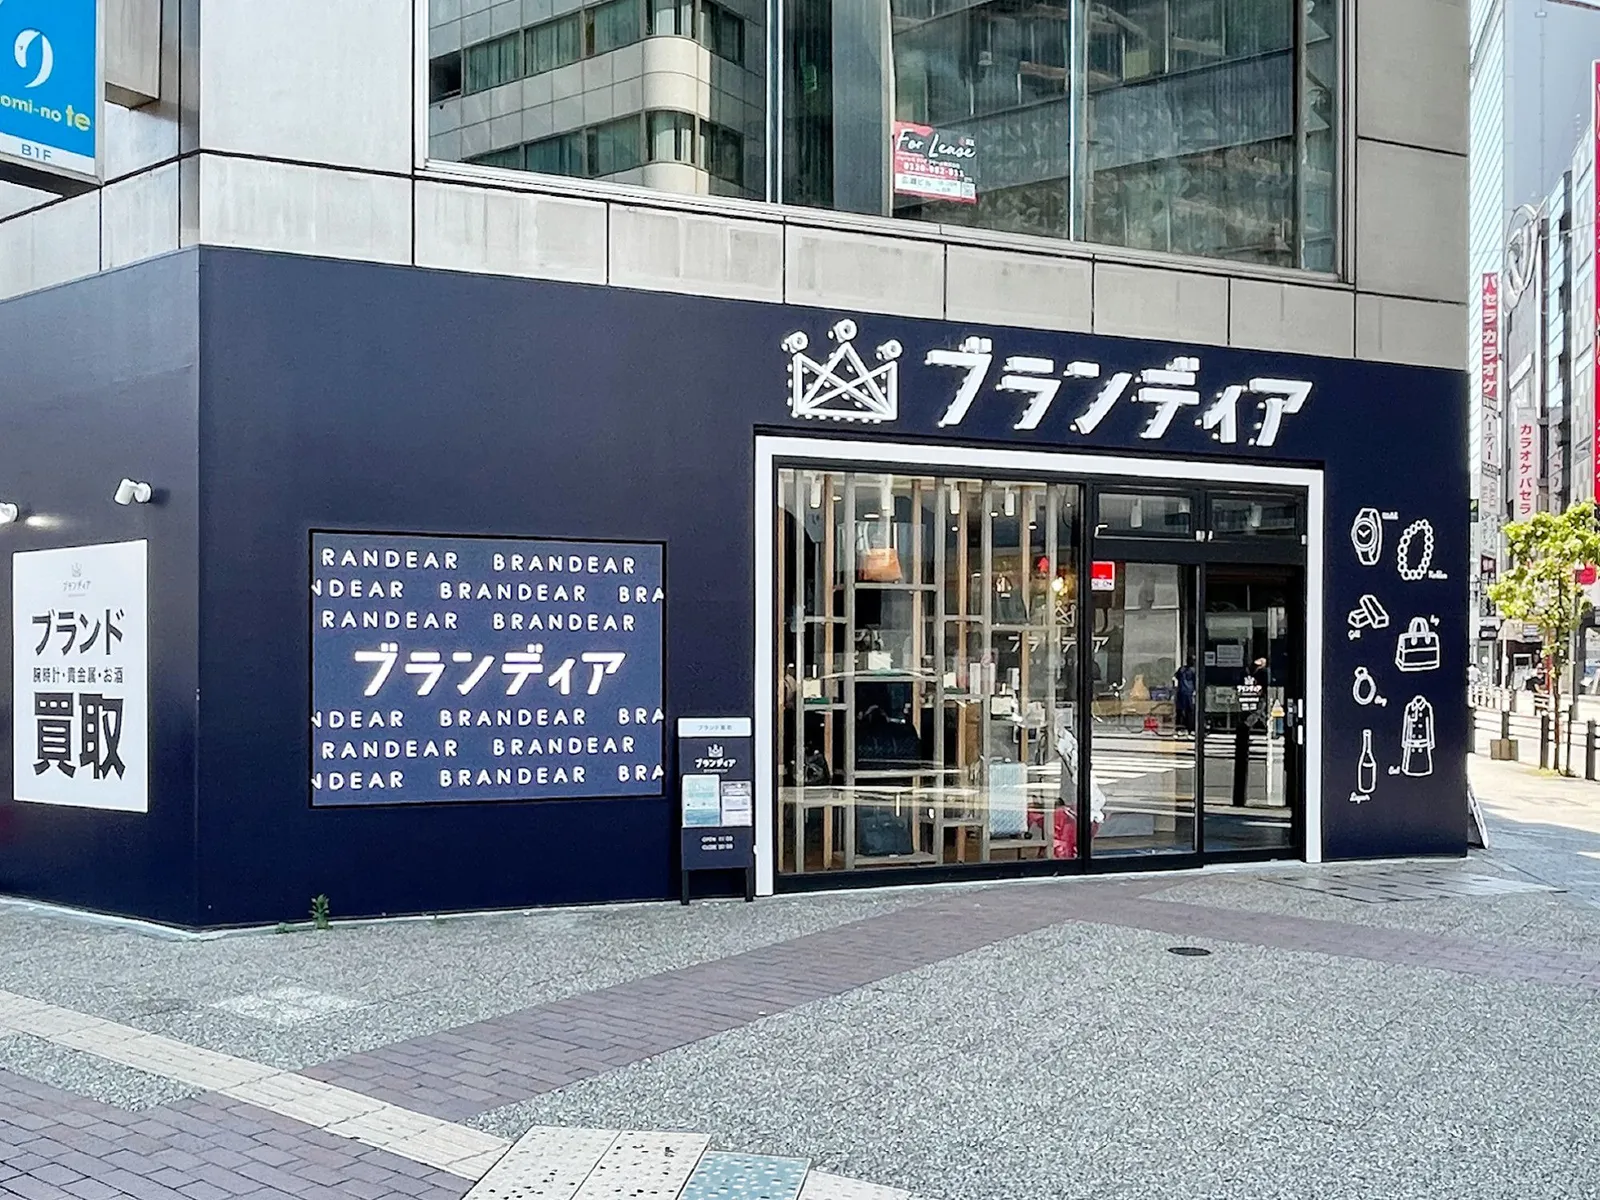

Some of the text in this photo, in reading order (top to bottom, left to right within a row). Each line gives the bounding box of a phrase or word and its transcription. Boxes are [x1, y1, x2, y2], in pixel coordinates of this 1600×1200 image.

[66, 105, 91, 131] te
[21, 143, 52, 161] B1F
[895, 128, 976, 158] For Lease
[924, 336, 1313, 447] ブランディア
[1519, 423, 1533, 516] カラオケパセラ
[321, 548, 635, 574] RANDEAR BRANDEAR
[440, 581, 586, 602] BRANDEAR
[619, 586, 664, 603] BRA
[32, 608, 125, 656] ブランド
[321, 609, 635, 632] RANDEAR BRANDEAR
[33, 666, 124, 684] 腕時計・貴金属・お酒
[354, 642, 626, 697] ブランディア
[439, 708, 586, 727] BRANDEAR
[618, 707, 664, 725] BRA
[32, 691, 126, 783] 買取
[321, 736, 634, 760] RANDEAR BRANDEAR
[440, 766, 585, 788] BRANDEAR
[618, 764, 664, 782] BRA
